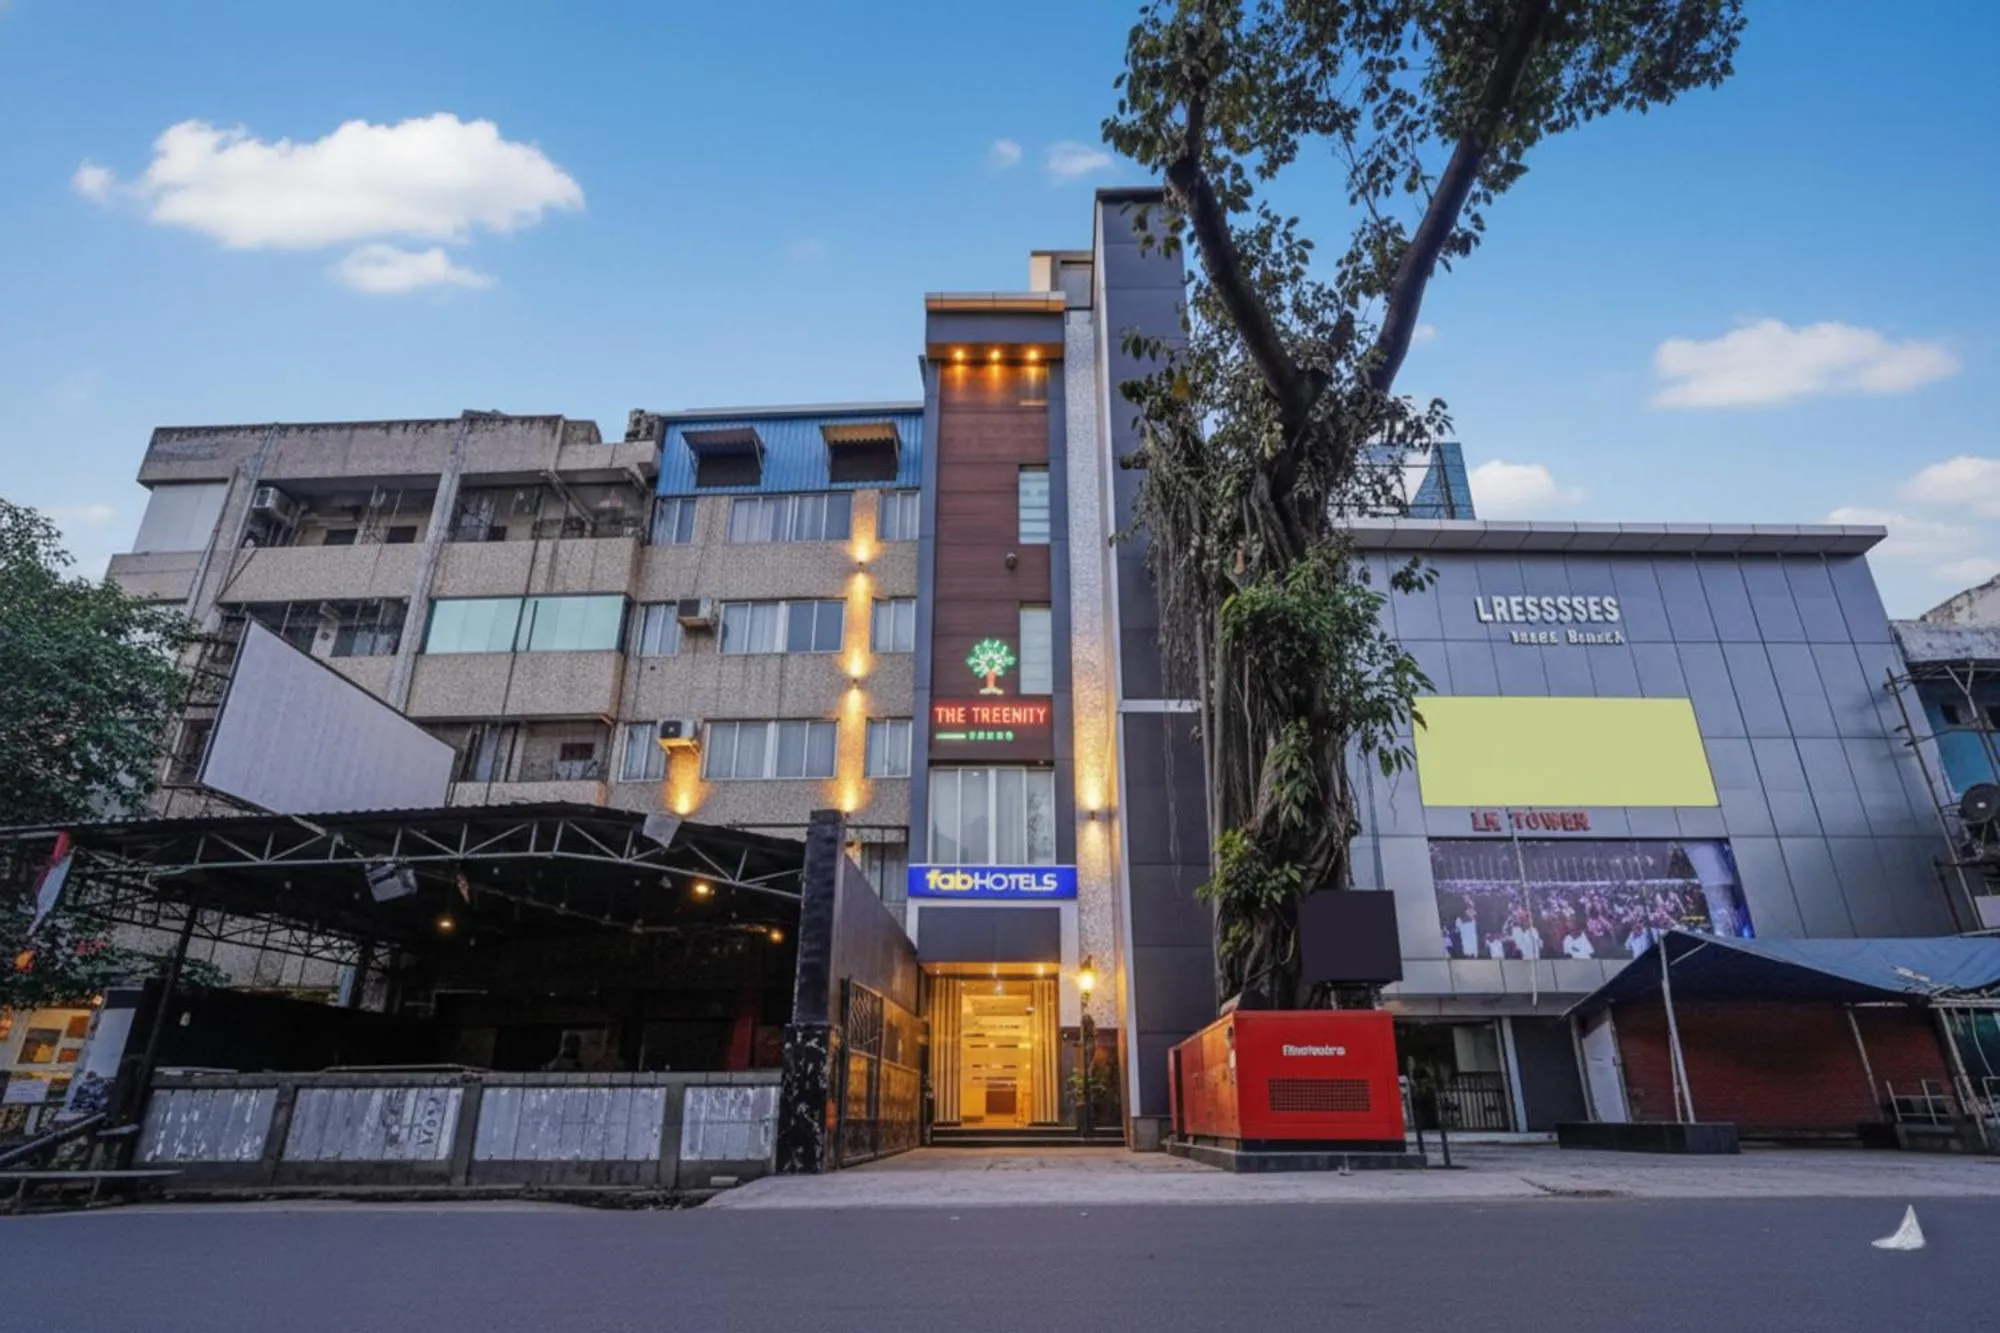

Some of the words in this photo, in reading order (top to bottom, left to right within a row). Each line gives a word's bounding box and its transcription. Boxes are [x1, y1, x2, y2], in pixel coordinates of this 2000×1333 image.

[935, 706, 966, 724] THE
[972, 706, 1048, 724] TREENITY
[926, 869, 1058, 892] fabHOTELS
